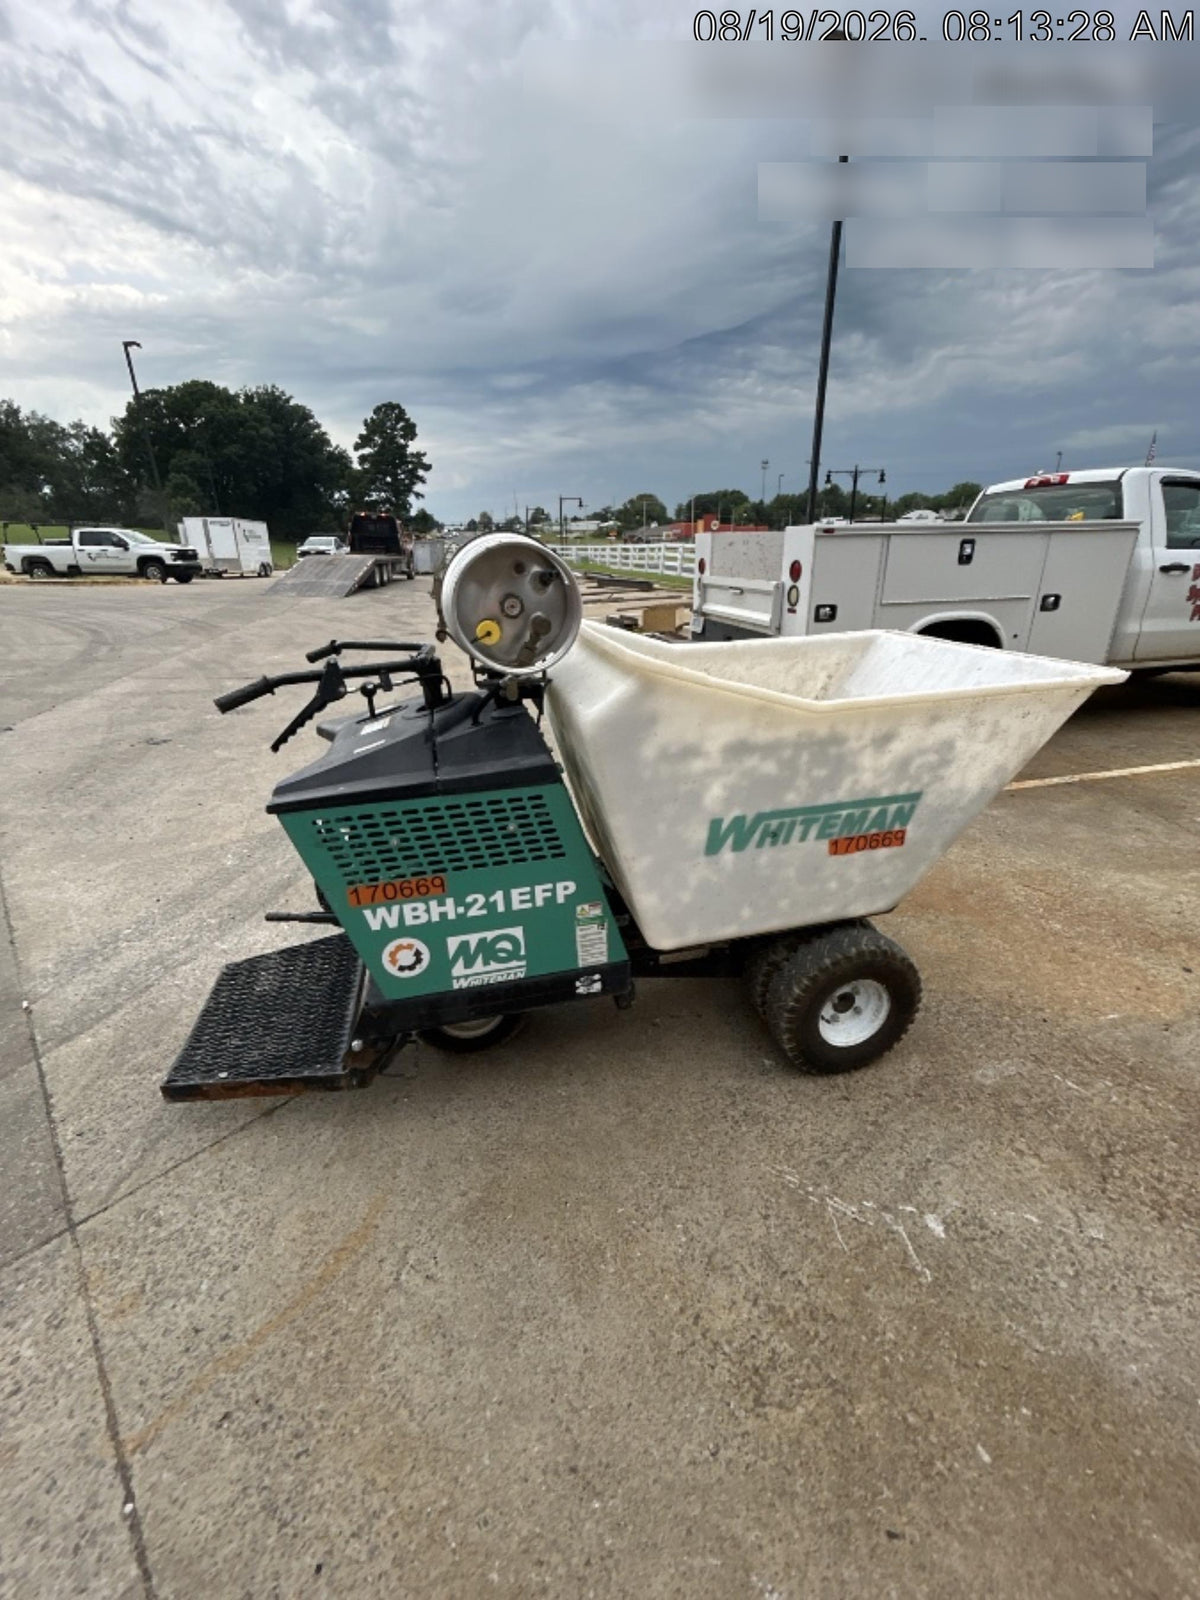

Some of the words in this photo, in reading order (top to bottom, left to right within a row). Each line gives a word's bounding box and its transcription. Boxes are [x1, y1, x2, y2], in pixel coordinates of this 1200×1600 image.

[704, 791, 923, 857] WHITEMAN
[830, 829, 906, 855] 170669
[349, 875, 446, 906] 170669
[362, 880, 577, 931] WBH-21EFP
[447, 928, 526, 974] MQ
[452, 966, 527, 990] WHITEMAN
